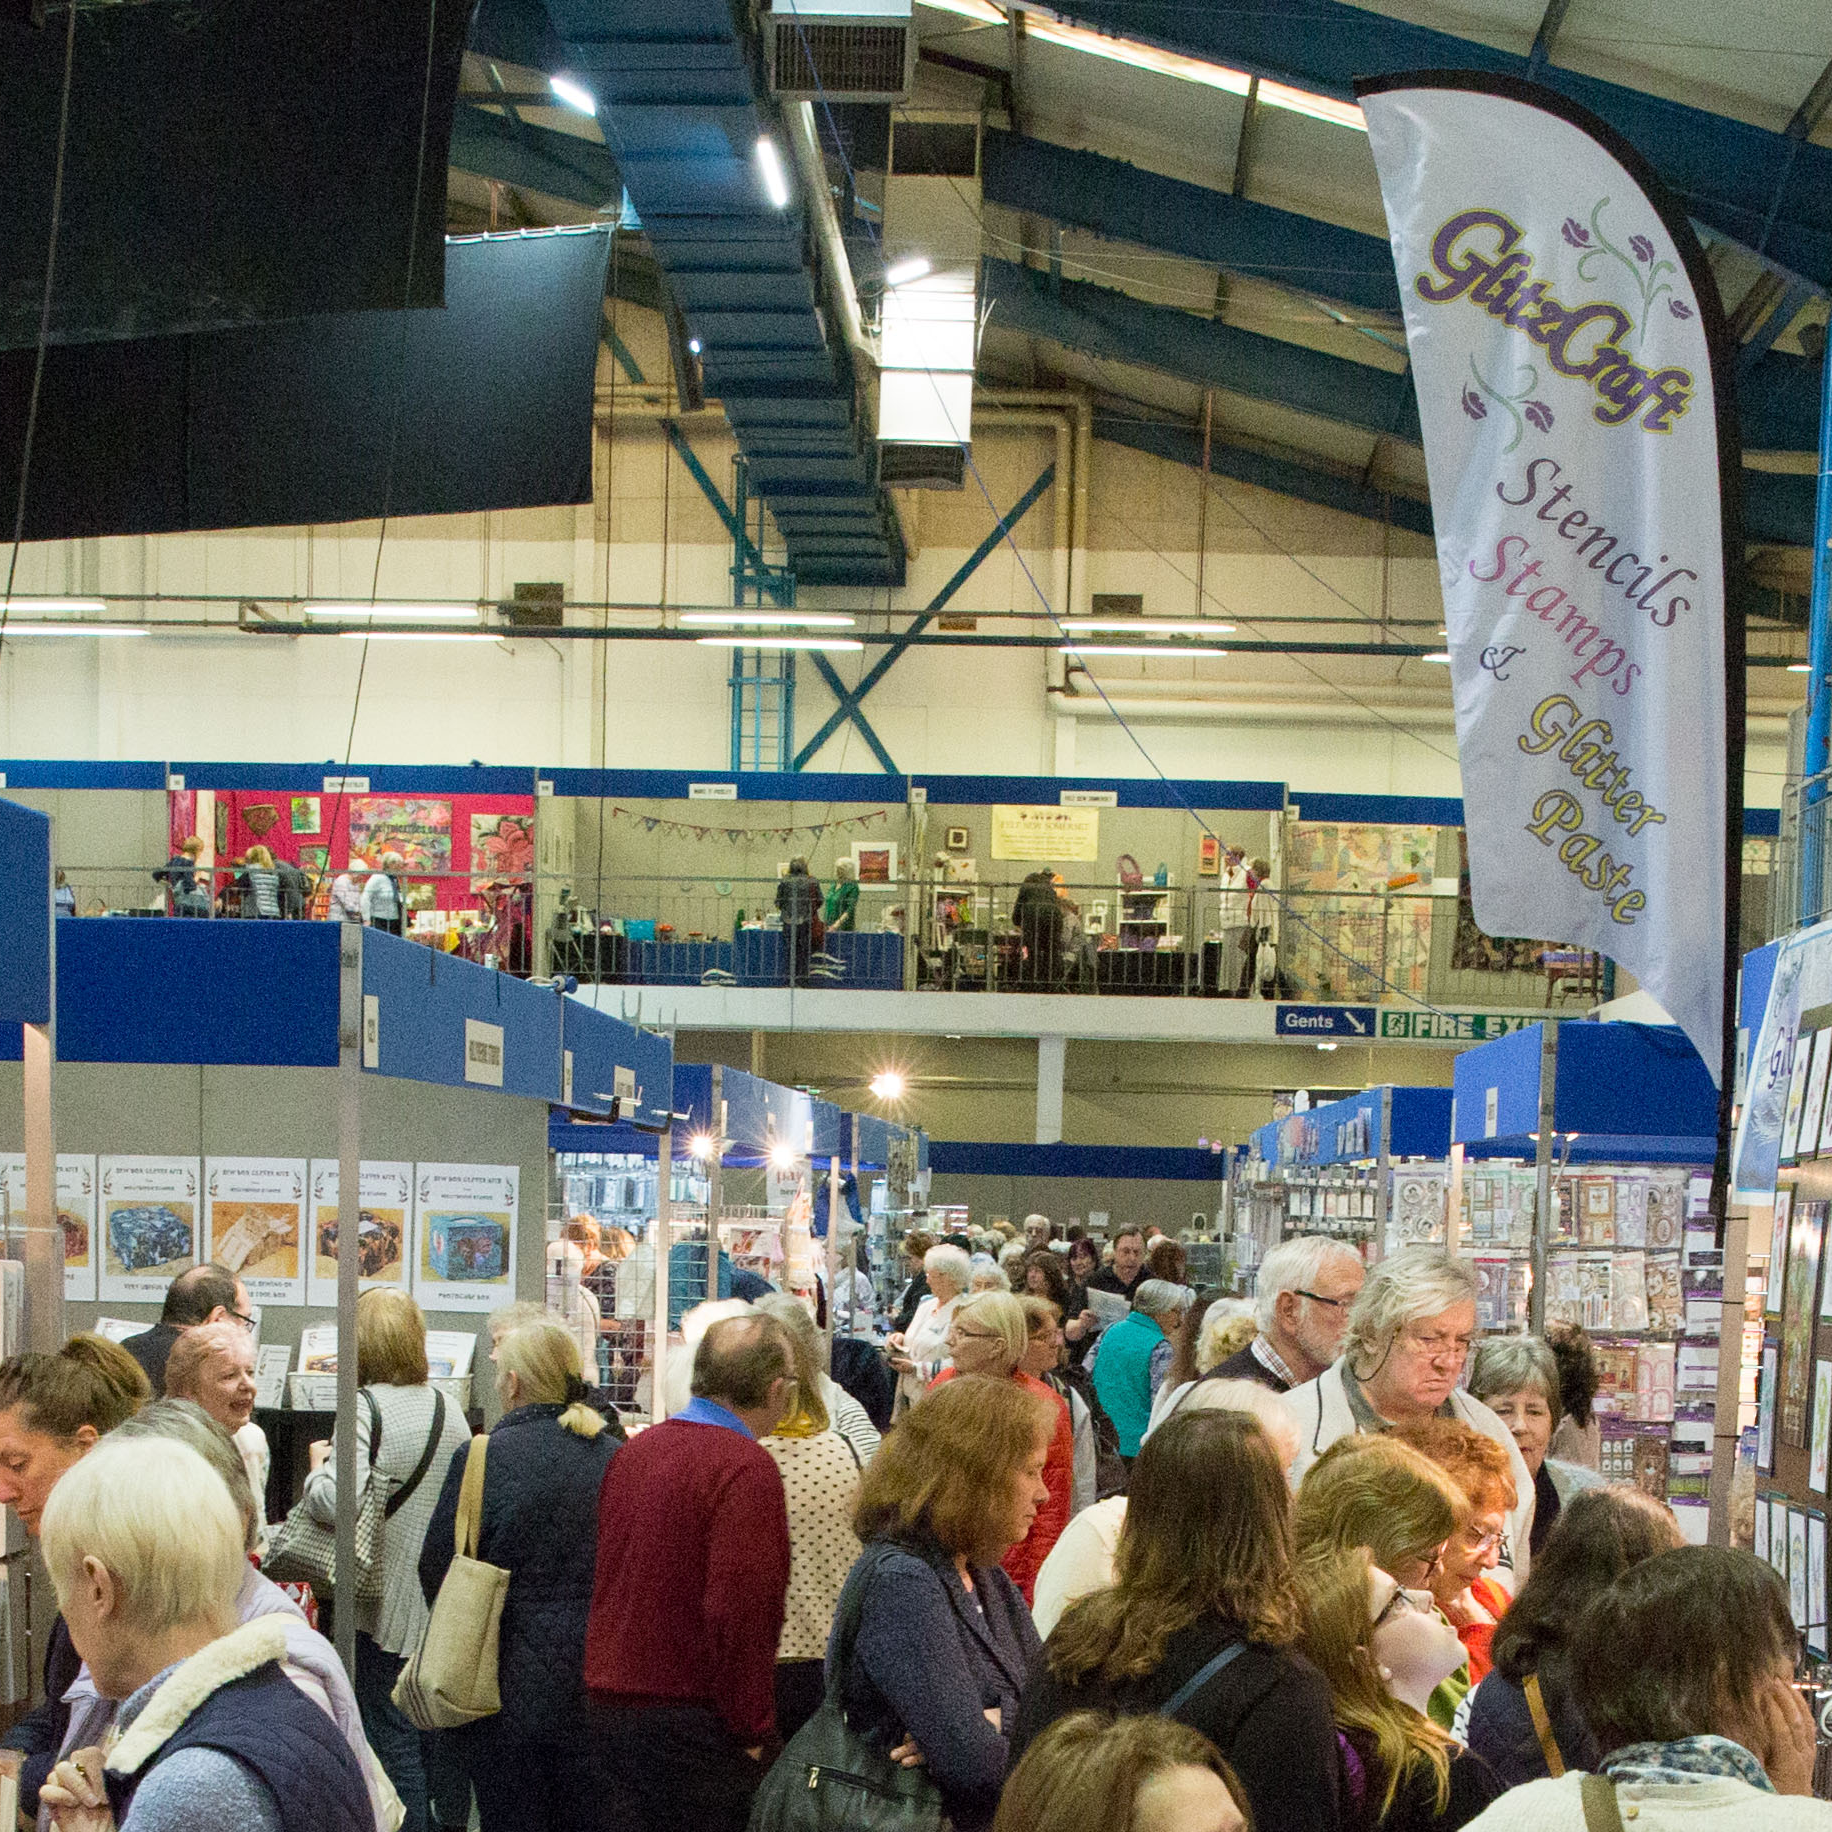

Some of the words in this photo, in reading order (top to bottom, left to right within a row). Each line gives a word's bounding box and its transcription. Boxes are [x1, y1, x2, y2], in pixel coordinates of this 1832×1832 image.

[1414, 208, 1696, 434] GlitzCraft
[1496, 458, 1697, 627] Stencils
[1469, 535, 1641, 695] Stamps
[1480, 646, 1526, 681] &
[1518, 693, 1666, 838] Glitter
[1524, 789, 1646, 925] Paste
[1285, 1013, 1334, 1029] Gents
[1414, 1014, 1474, 1039] FIRE
